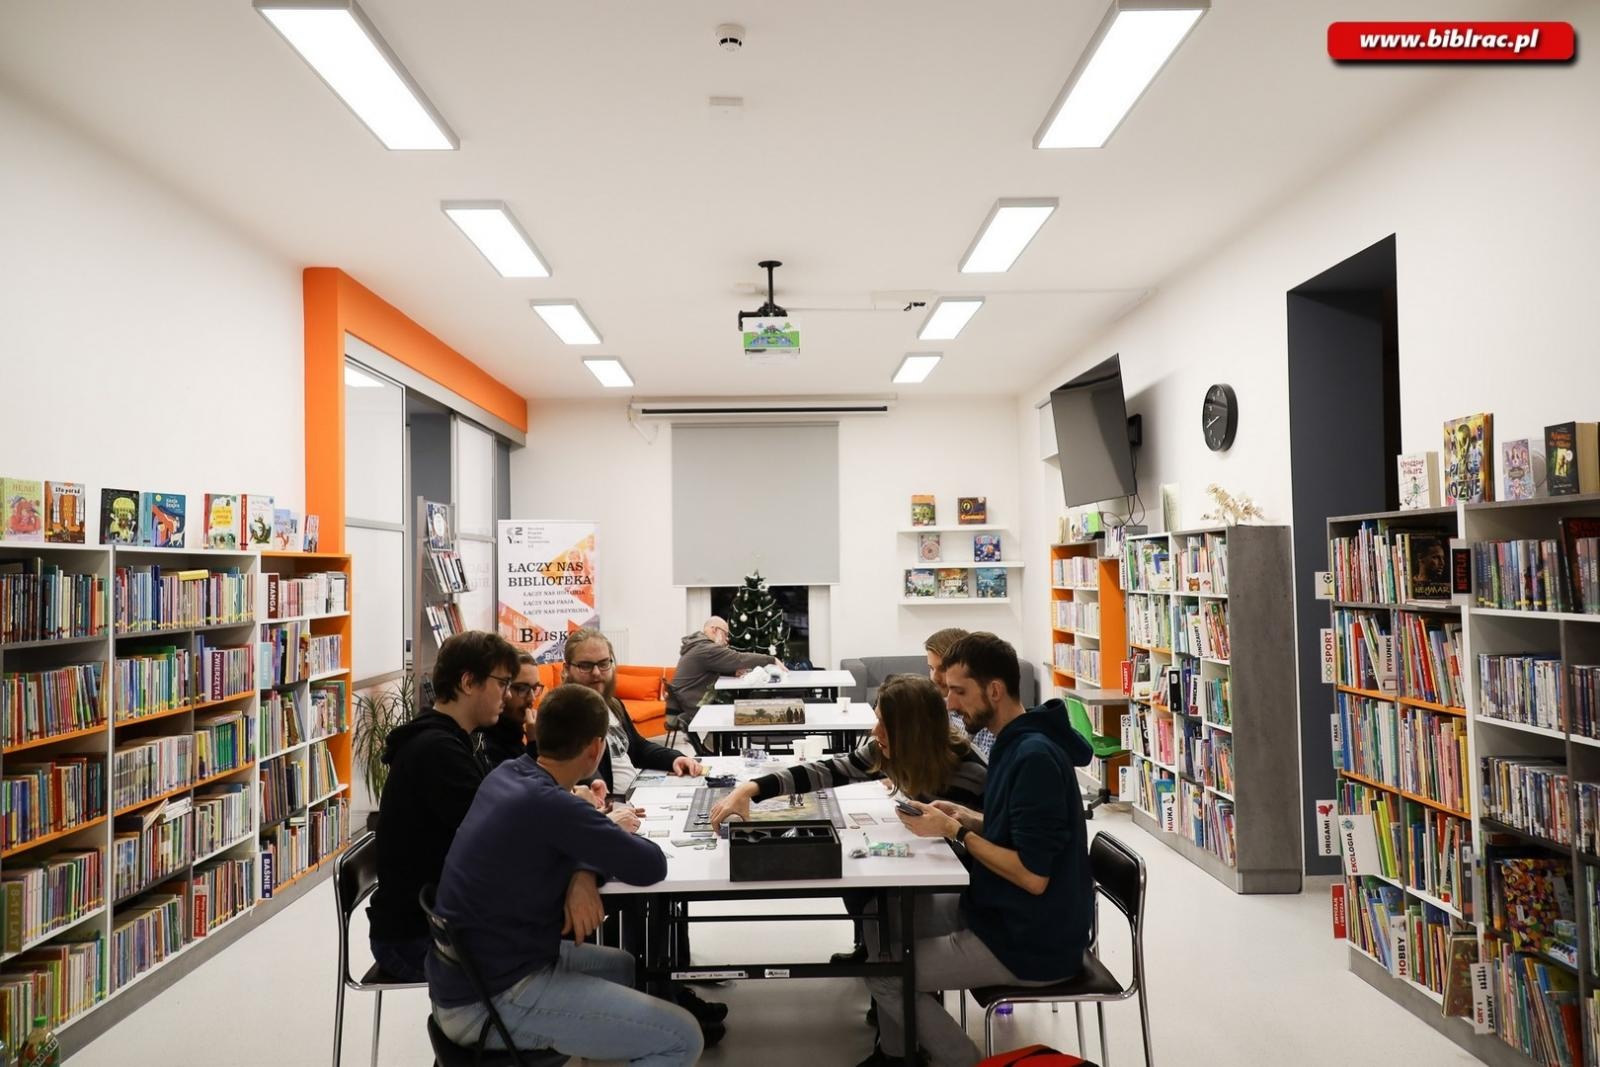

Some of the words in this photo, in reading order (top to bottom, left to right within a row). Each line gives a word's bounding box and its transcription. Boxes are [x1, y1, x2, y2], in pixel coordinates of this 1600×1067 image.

[508, 575, 592, 587] BIBLIOTEKA
[556, 561, 584, 572] NAS
[1455, 552, 1468, 590] NETFLIX
[269, 581, 277, 612] MANGA
[1414, 585, 1451, 596] NEYMAR
[520, 627, 574, 643] BLISK
[1194, 625, 1203, 657] DINOZAURY
[1324, 631, 1333, 663] SPORT
[1386, 637, 1394, 673] RYSUNEK
[213, 652, 221, 695] ZWIERZĘTA
[1323, 820, 1331, 854] ORIGAMI
[1347, 832, 1358, 873] EKOLOGIA
[263, 858, 271, 890] BAŚNIE
[1397, 937, 1407, 976] HOBBY
[1486, 994, 1495, 1029] ZABAWY
